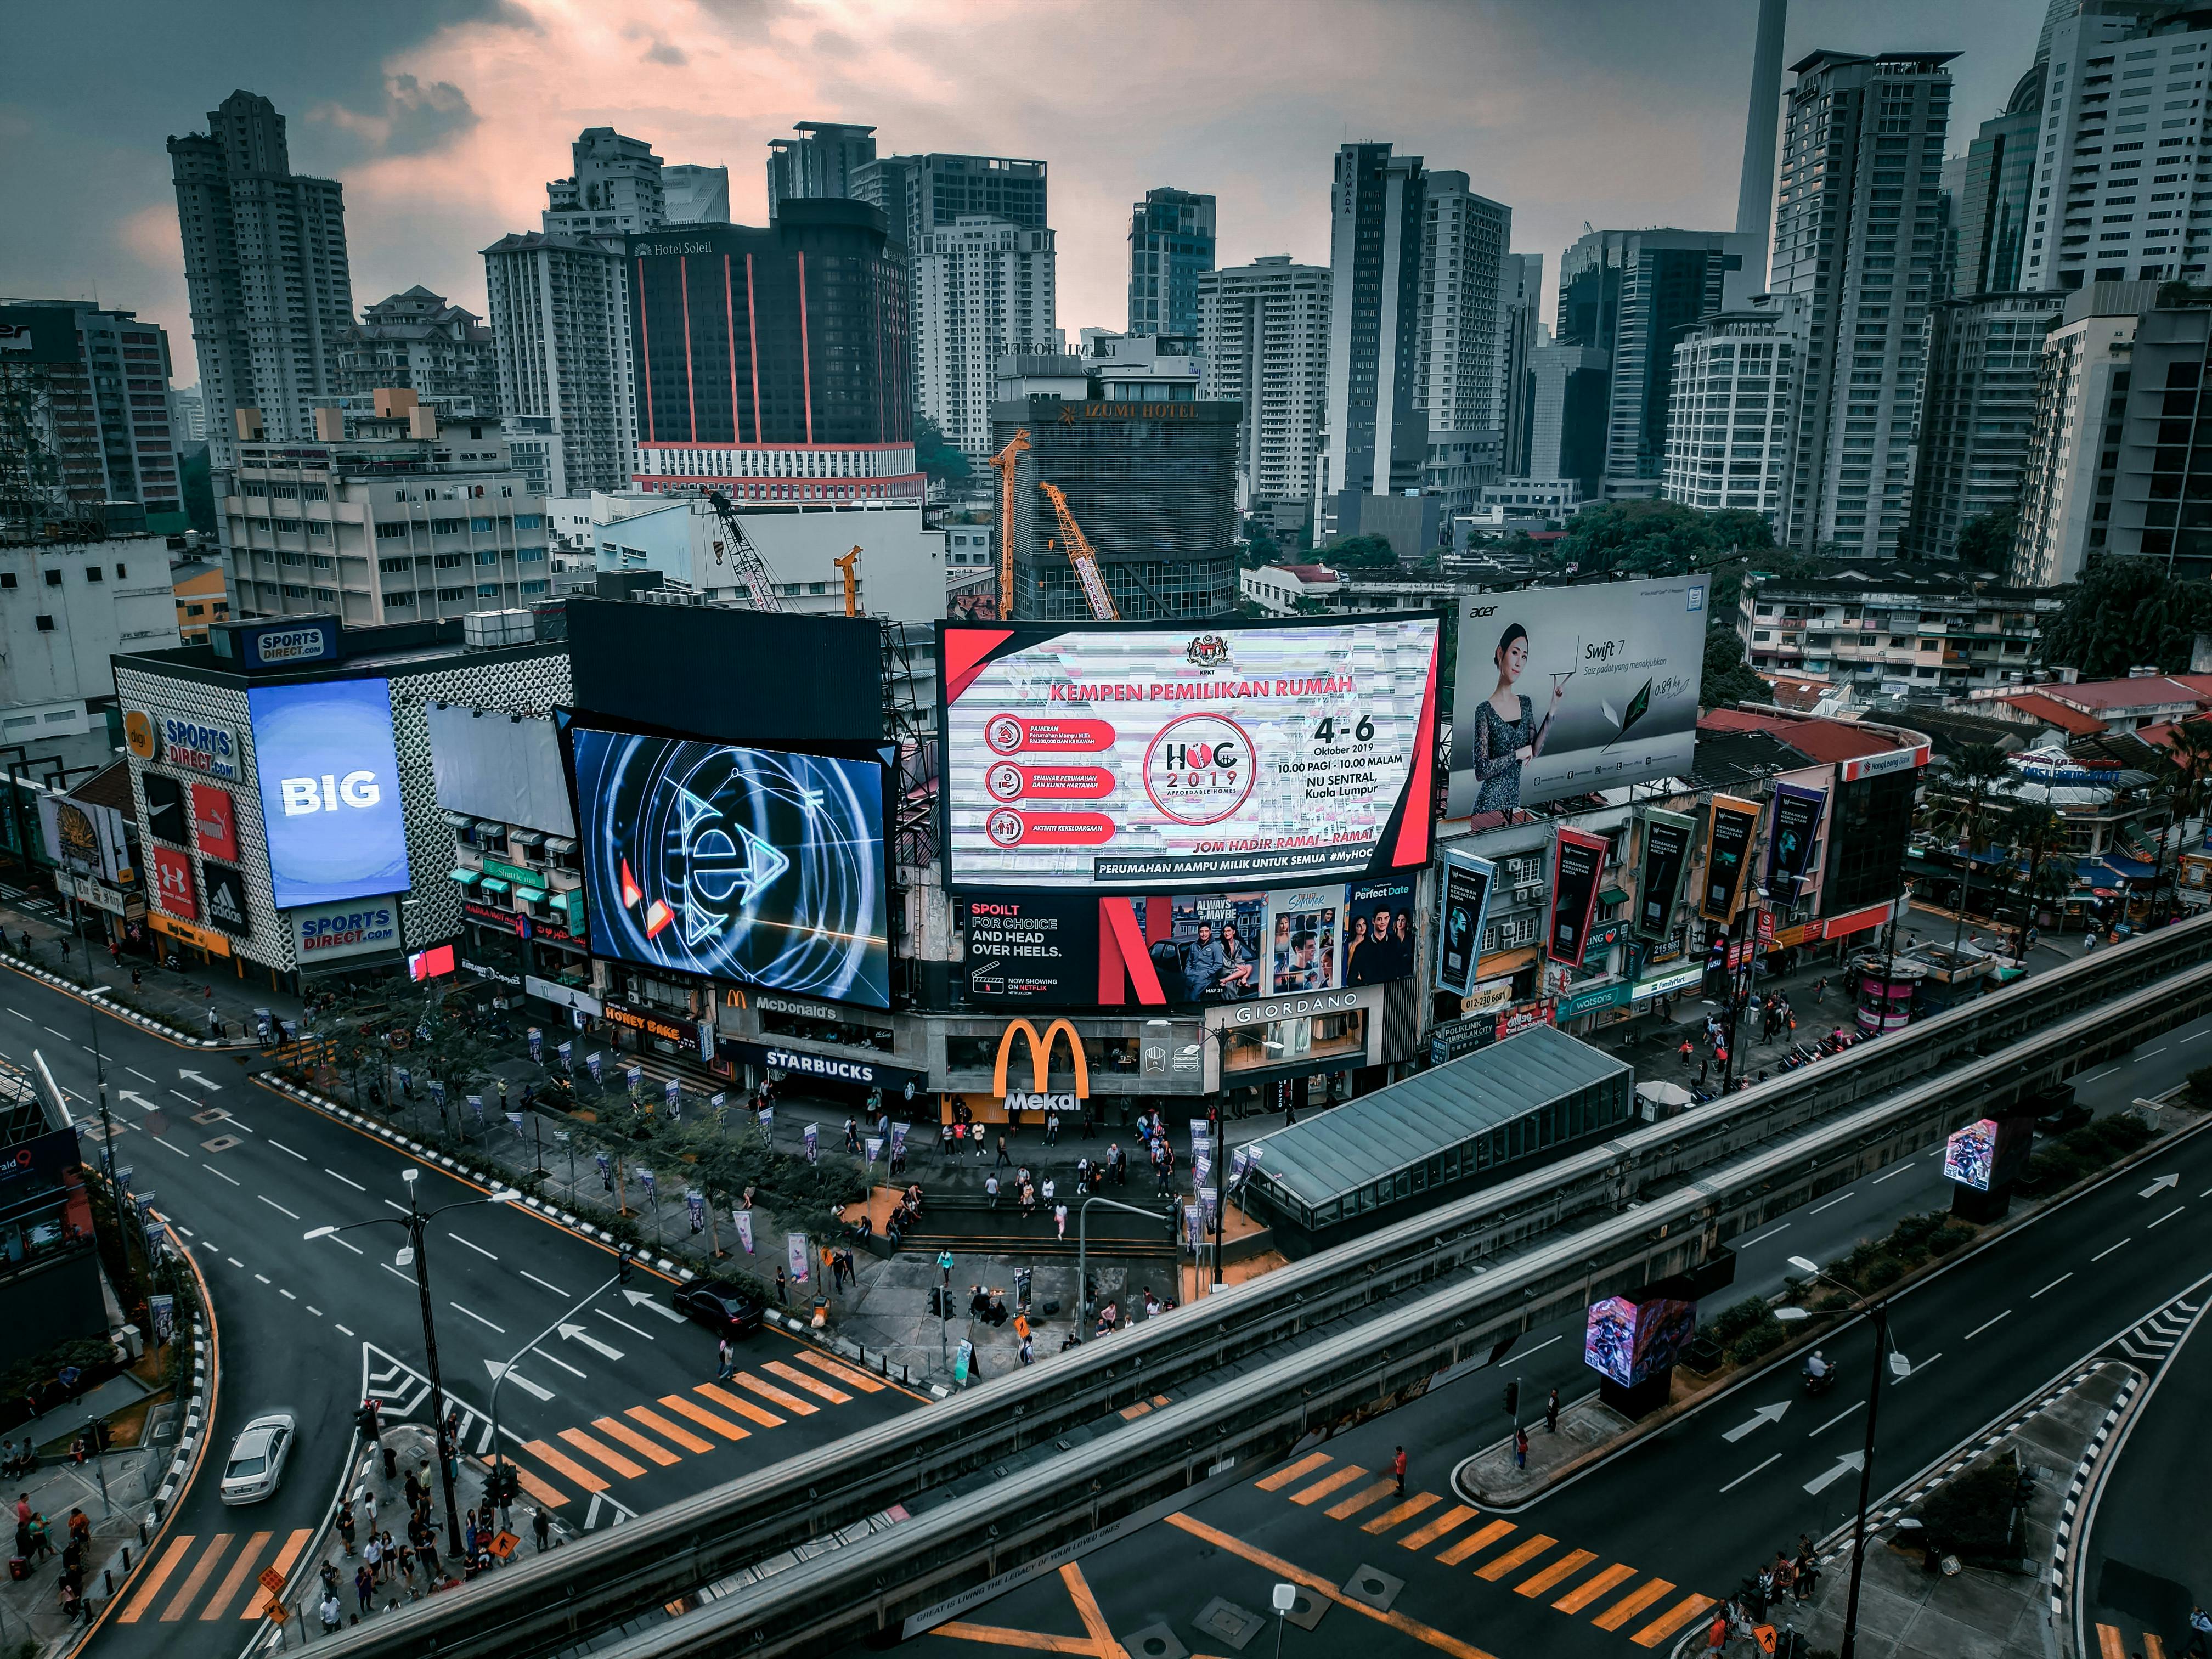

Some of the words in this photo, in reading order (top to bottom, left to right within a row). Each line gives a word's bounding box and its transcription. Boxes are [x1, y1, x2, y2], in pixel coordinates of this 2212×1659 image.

[1344, 162, 1353, 215] RAMADA
[655, 245, 681, 255] Hotel
[684, 241, 712, 254] Soleil
[1085, 404, 1136, 419] IZUMI
[1142, 404, 1199, 419] HOTEL
[1082, 569, 1104, 618] PINTARAS
[1470, 606, 1498, 618] acer
[262, 631, 319, 649] SPORTS
[263, 646, 320, 659] DIRECT.COM
[1585, 640, 1615, 662] Swift
[1618, 640, 1625, 656] 7
[1596, 664, 1615, 676] padat
[1615, 662, 1629, 674] yang
[1051, 684, 1143, 701] KEMPEN
[1150, 680, 1269, 701] PEMILIKAN
[1276, 675, 1352, 696] RUMAH
[1655, 677, 1672, 696] 0.89
[166, 718, 232, 756] SPORTS
[1314, 747, 1350, 756] Oktober
[1352, 743, 1374, 753] 2019
[170, 744, 233, 777] DIRECT.COM
[1278, 763, 1306, 774] 10.00
[1307, 761, 1331, 772] PAGI
[1340, 758, 1365, 769] 10.00
[1368, 754, 1402, 766] MALAM
[1899, 756, 1910, 764] Bank
[1166, 771, 1237, 788] 2019
[1307, 776, 1325, 787] NU
[1328, 772, 1378, 786] SENTRAL,
[281, 771, 381, 815] BIG
[1305, 787, 1336, 799] Kuala
[1339, 785, 1378, 797] Lumpur
[1781, 810, 1808, 819] KERAHKAN
[1781, 815, 1807, 823] KEKUATAN
[198, 819, 224, 840] PUMA
[1717, 825, 1743, 833] KERAHKAN
[1717, 829, 1742, 838] KEKUATAN
[1193, 840, 1225, 854] JOM
[1228, 838, 1272, 851] HADIR
[1276, 834, 1320, 848] RAMAI
[1331, 830, 1373, 843] RAMAI
[1651, 839, 1677, 849] KERAHKAN
[1651, 844, 1677, 854] KEKUATAN
[1099, 863, 1171, 873] PERUMAHAN
[1173, 860, 1217, 872] MAMPU
[1220, 859, 1250, 870] MILIK
[1252, 857, 1288, 867] UNTUK
[1290, 854, 1326, 865] SEMUA
[1330, 848, 1373, 862] #MyHOC
[1562, 859, 1589, 870] KERAHKAN
[497, 869, 521, 881] Shuttle
[1562, 864, 1588, 874] KEKUATAN
[1355, 888, 1387, 900] Perfect
[1389, 885, 1409, 895] Date
[1450, 889, 1476, 900] KEKUATAN
[1451, 884, 1476, 895] KERAHKAN
[972, 904, 1019, 915] SPOILT
[1197, 899, 1231, 911] ALWAYS
[211, 904, 242, 924] adidas
[1207, 909, 1237, 920] MAYBE
[301, 909, 390, 937] SPORTS
[972, 917, 1001, 928] FOR
[1003, 918, 1057, 930] CHOICE
[303, 928, 393, 951] DIRECT.COM
[972, 930, 1003, 941] AND
[1006, 932, 1045, 943] HEAD
[972, 944, 1011, 956] OVER
[1013, 945, 1062, 957] HEELS.
[1654, 943, 1667, 954] 215
[1659, 975, 1685, 989] FamilyMart
[757, 997, 836, 1019] McDonald's
[1236, 993, 1357, 1023] GIORDANO
[1466, 996, 1491, 1008] 012-230
[1576, 993, 1612, 1009] watsons
[606, 1007, 645, 1029] HONEY
[647, 1020, 680, 1040] BAKE
[1445, 1020, 1482, 1036] POLIKLINIK
[1478, 1024, 1493, 1035] CITY
[767, 1052, 873, 1081] STARBUCKS
[917, 1605, 945, 1622] GREAT
[947, 1599, 956, 1608] IS
[957, 1588, 985, 1604] LIVING
[987, 1579, 1003, 1591] THE
[1005, 1563, 1036, 1583] LEGACY
[1037, 1556, 1049, 1565] OF
[1050, 1546, 1071, 1561] YOUR
[1073, 1533, 1098, 1551] LOVED
[1100, 1522, 1121, 1538] ONES
